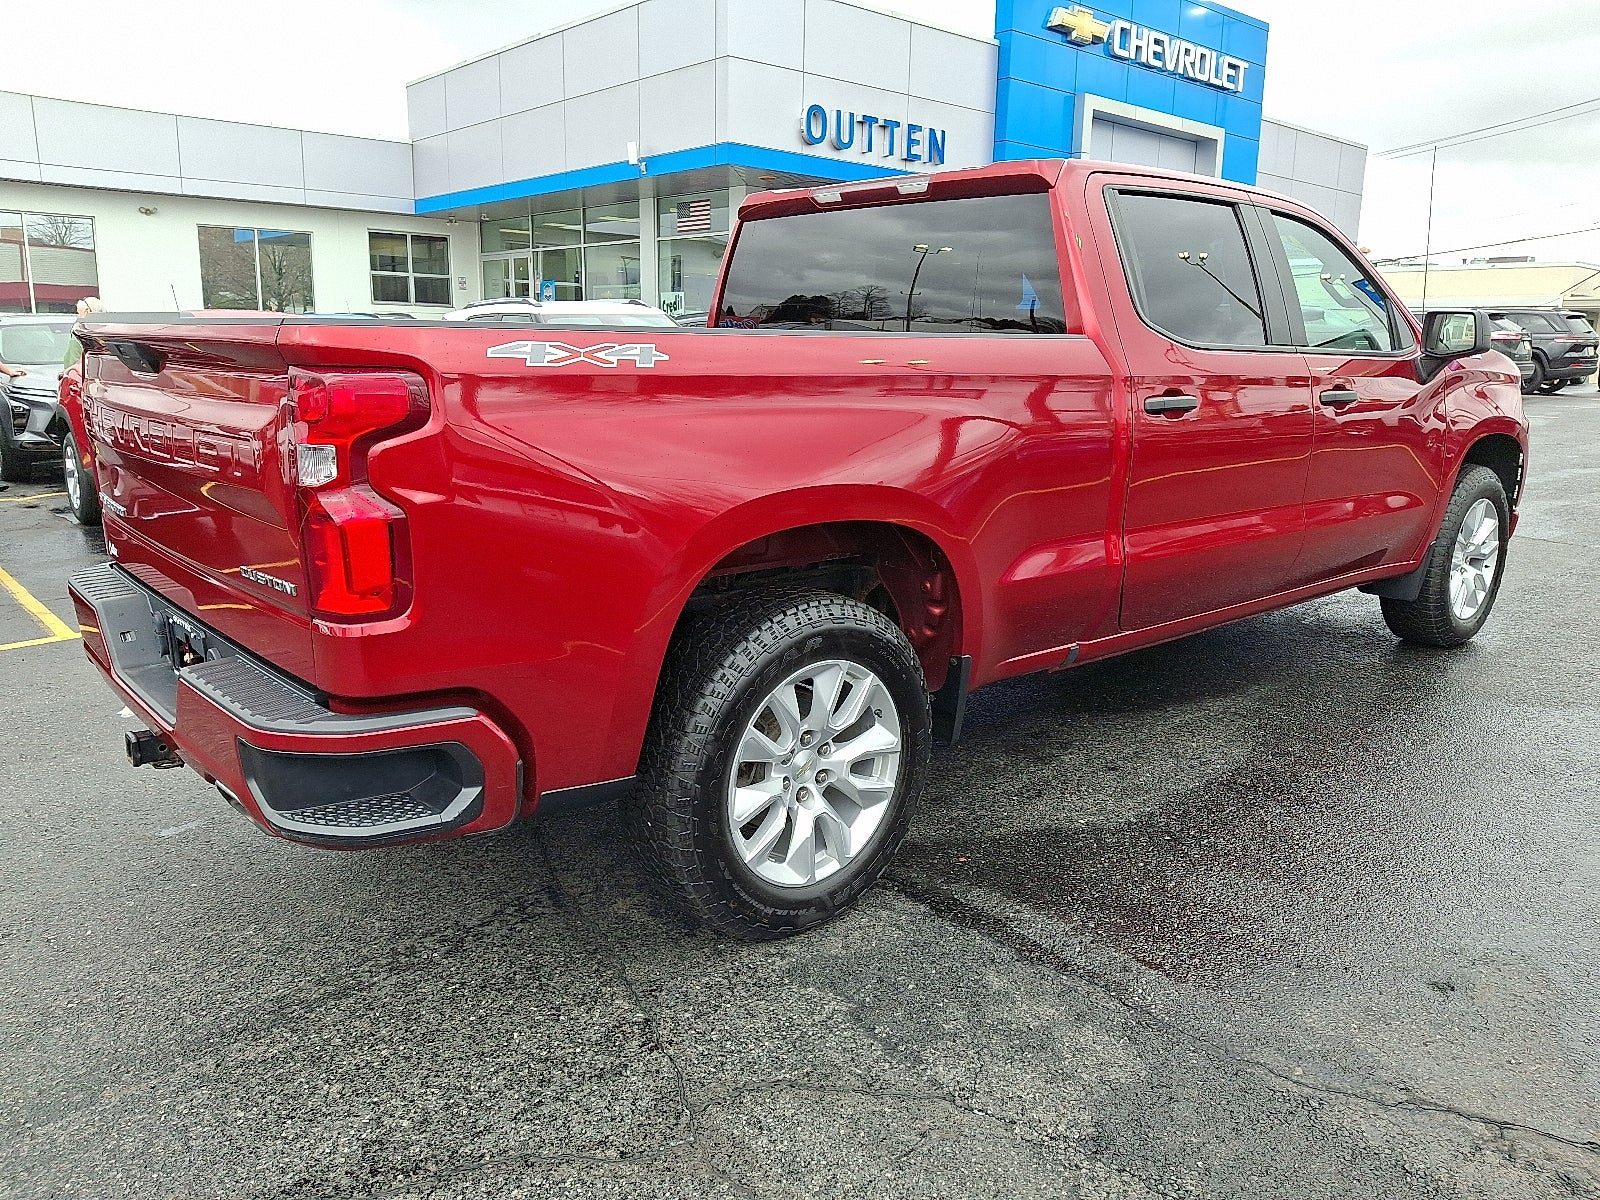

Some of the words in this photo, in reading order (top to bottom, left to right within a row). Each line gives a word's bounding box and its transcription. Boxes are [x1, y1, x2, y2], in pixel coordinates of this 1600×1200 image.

[1110, 19, 1249, 93] CHEVROLET
[801, 104, 946, 165] OUTTEN
[240, 565, 298, 597] CUSTOM
